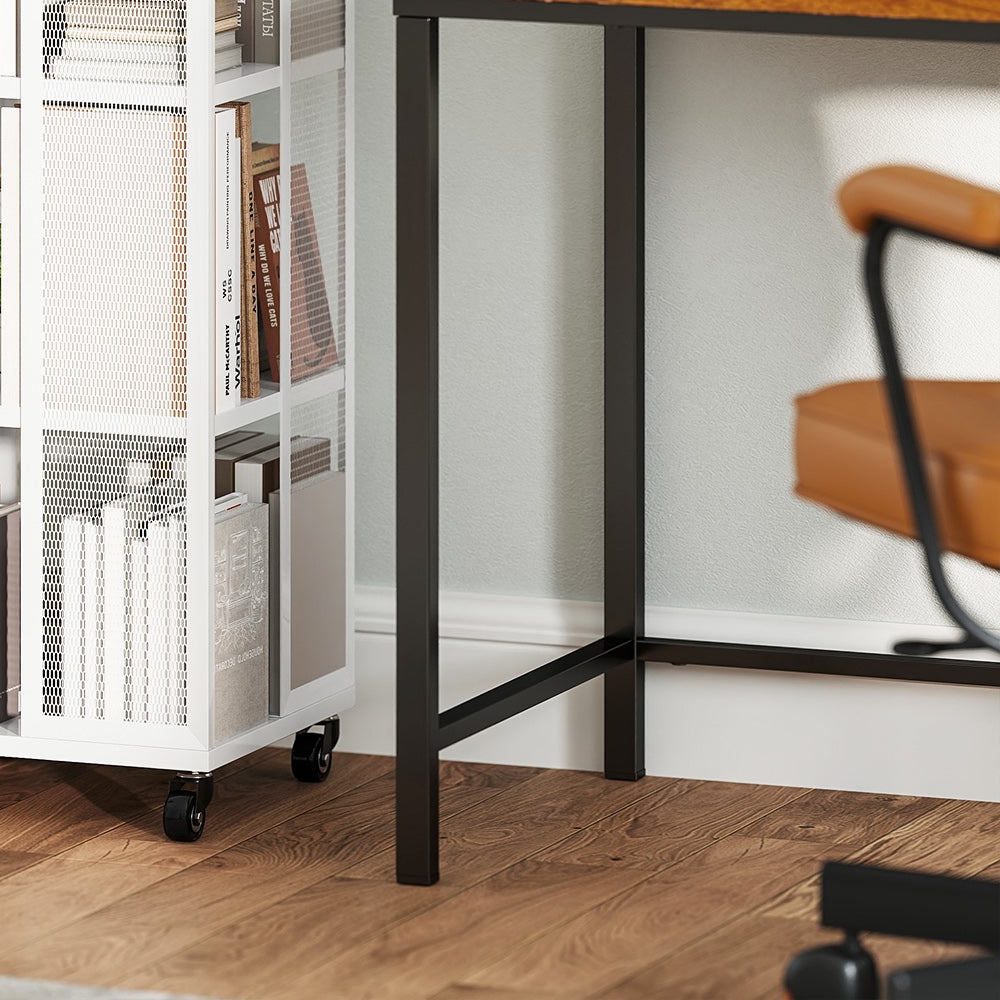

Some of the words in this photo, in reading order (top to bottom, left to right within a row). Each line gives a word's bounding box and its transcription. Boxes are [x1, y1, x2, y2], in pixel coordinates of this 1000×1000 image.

[258, 244, 267, 261] WHY
[261, 262, 269, 274] DO
[263, 275, 272, 287] WE
[265, 288, 275, 308] LOVE
[268, 308, 278, 328] CATS
